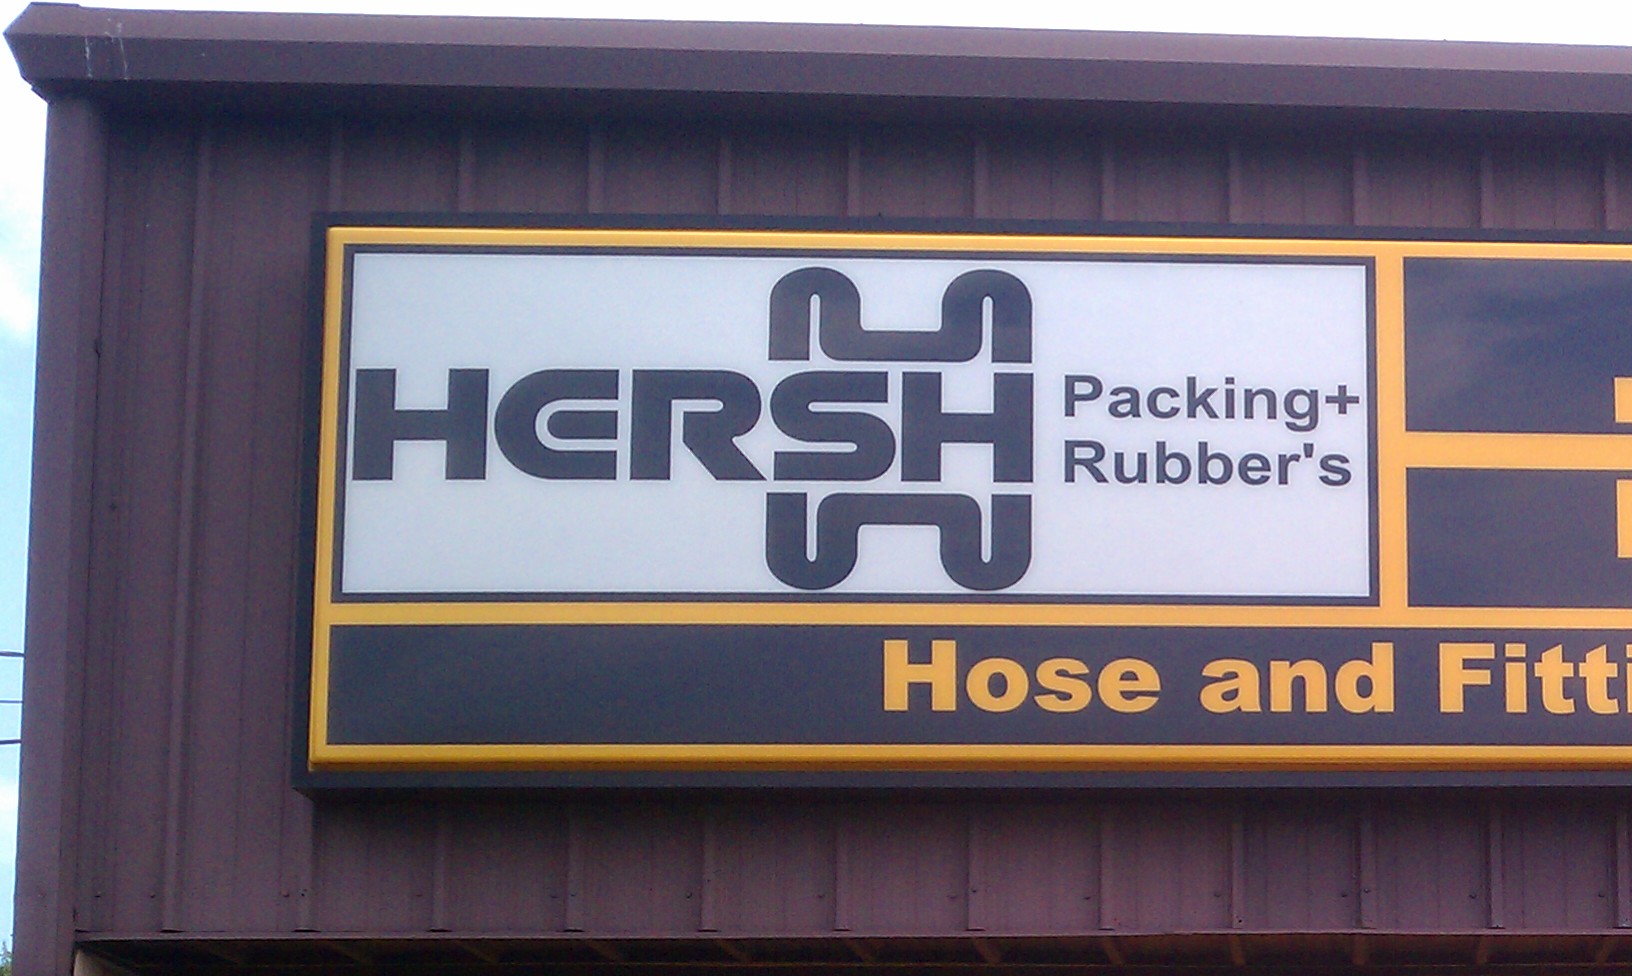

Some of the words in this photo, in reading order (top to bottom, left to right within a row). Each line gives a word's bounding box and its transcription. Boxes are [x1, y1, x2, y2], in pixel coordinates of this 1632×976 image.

[352, 368, 1034, 483] HERSH
[1062, 440, 1353, 487] Rubber's
[882, 638, 1162, 714] Hose
[1199, 640, 1396, 716] and
